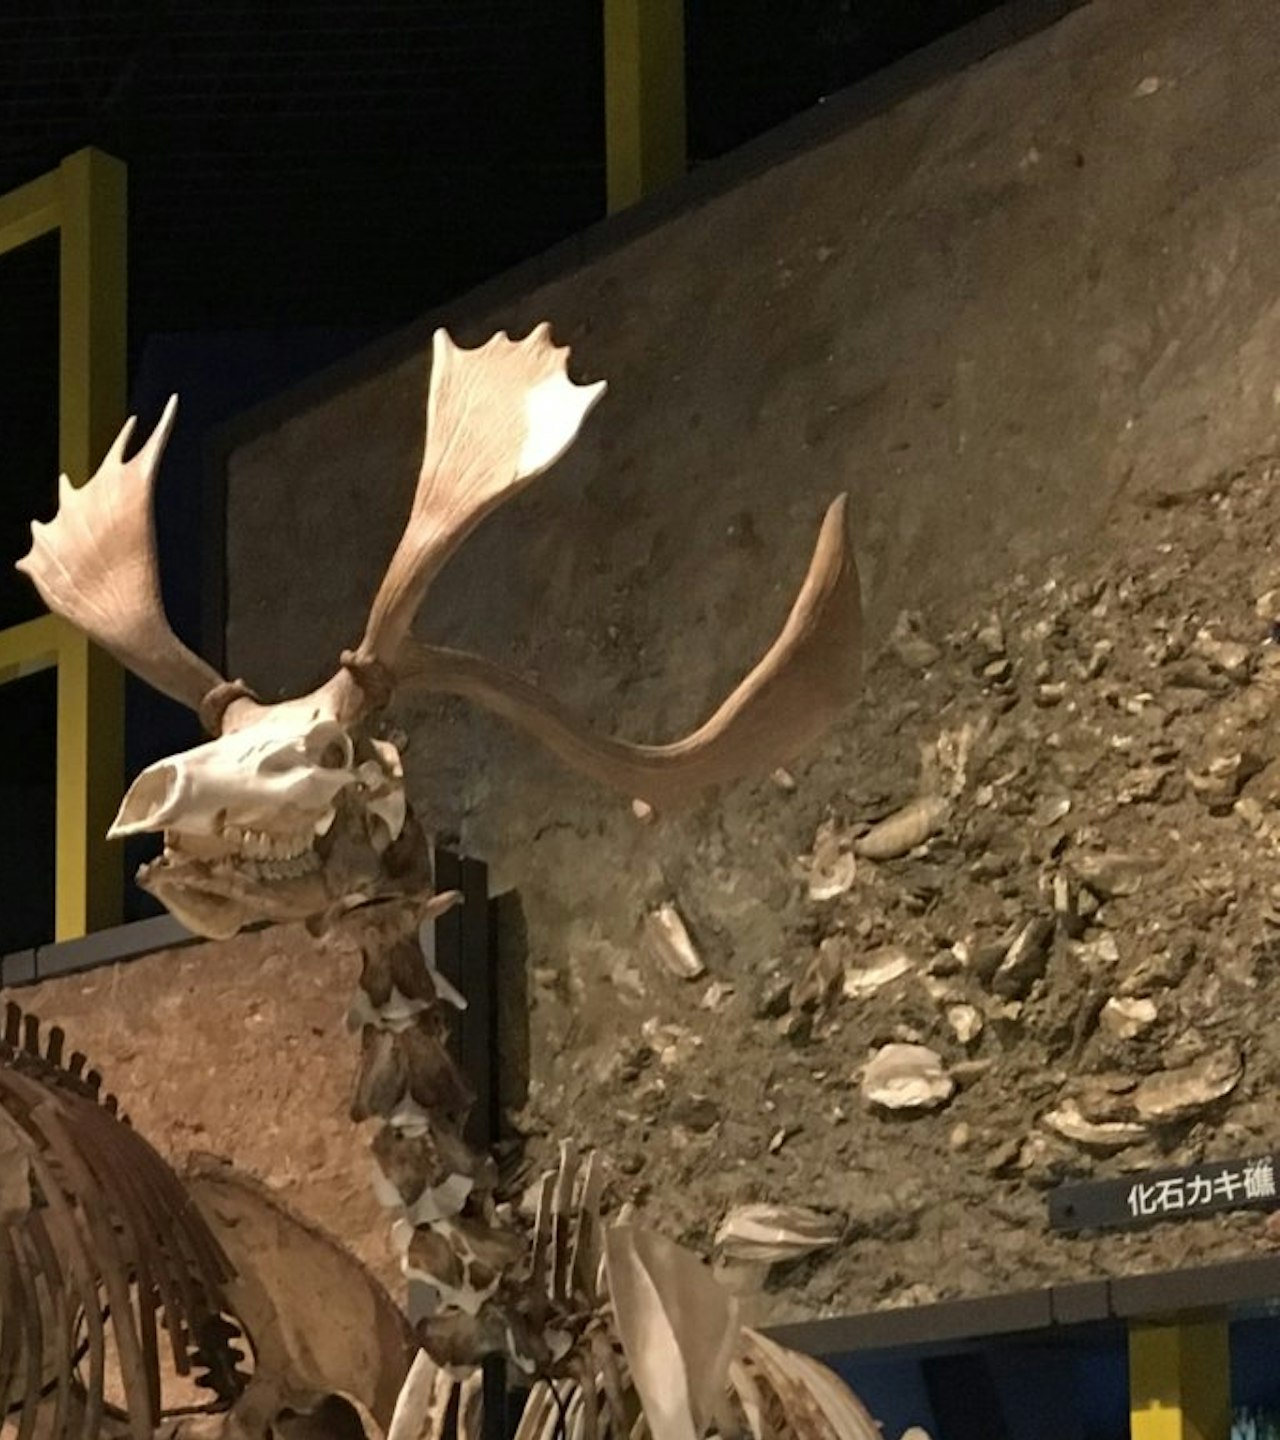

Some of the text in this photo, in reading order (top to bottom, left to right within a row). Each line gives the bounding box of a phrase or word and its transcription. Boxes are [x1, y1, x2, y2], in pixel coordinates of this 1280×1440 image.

[1127, 1165, 1276, 1217] 化石カキ礁
